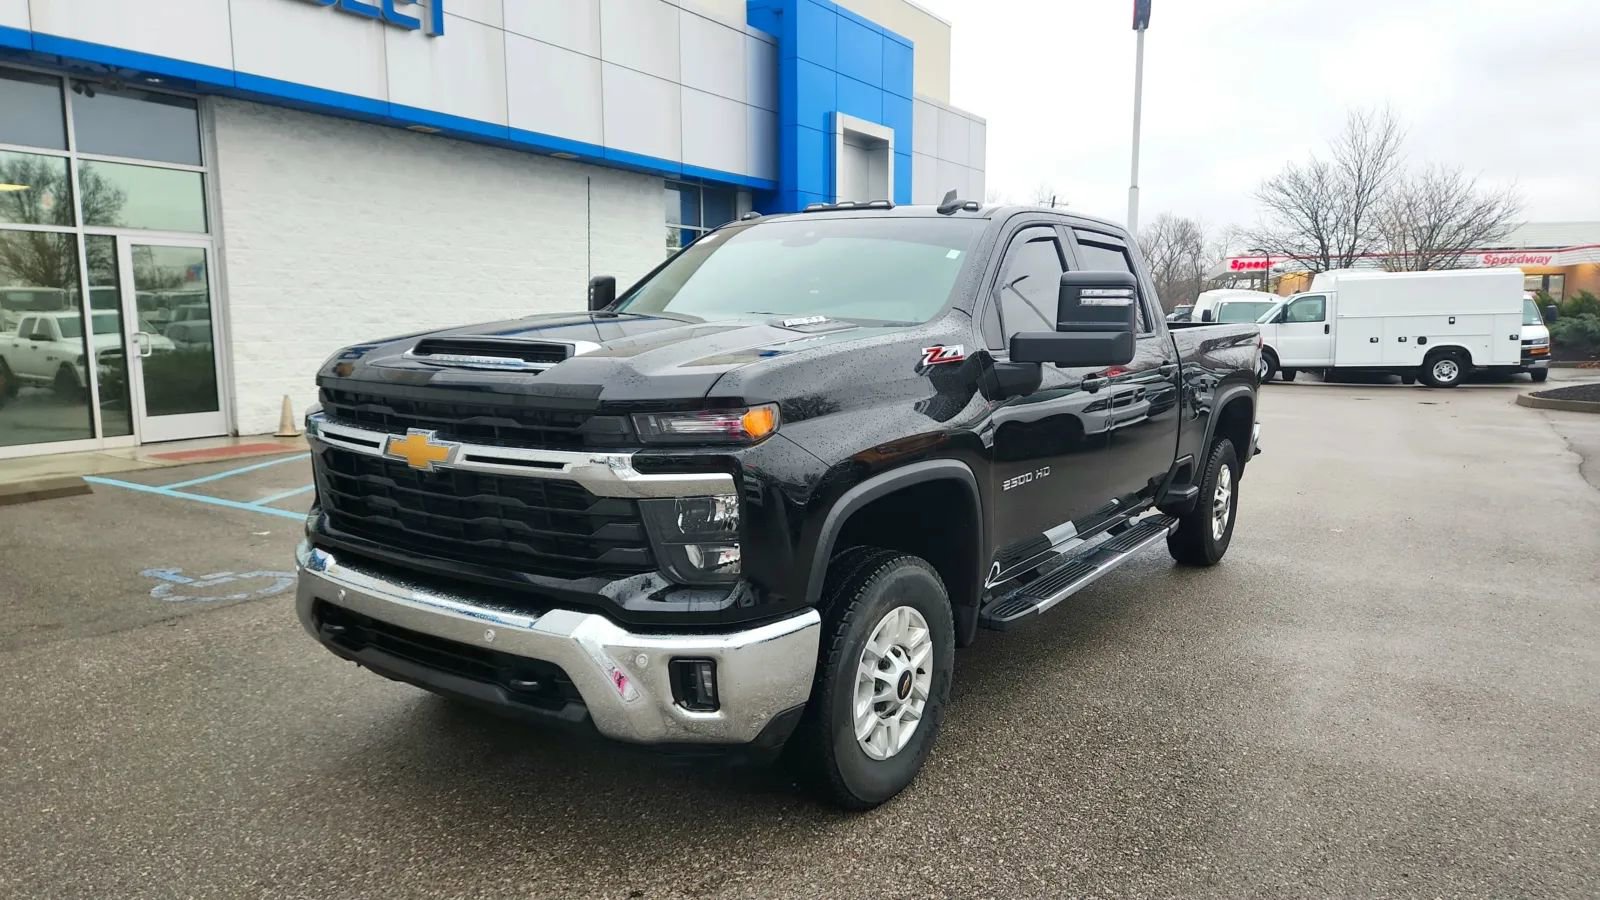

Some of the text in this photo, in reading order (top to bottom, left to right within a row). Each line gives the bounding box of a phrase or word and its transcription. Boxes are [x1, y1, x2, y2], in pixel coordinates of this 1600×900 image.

[1482, 253, 1553, 266] Speedway
[921, 343, 965, 366] Z71
[1001, 465, 1051, 492] 2500 HD
